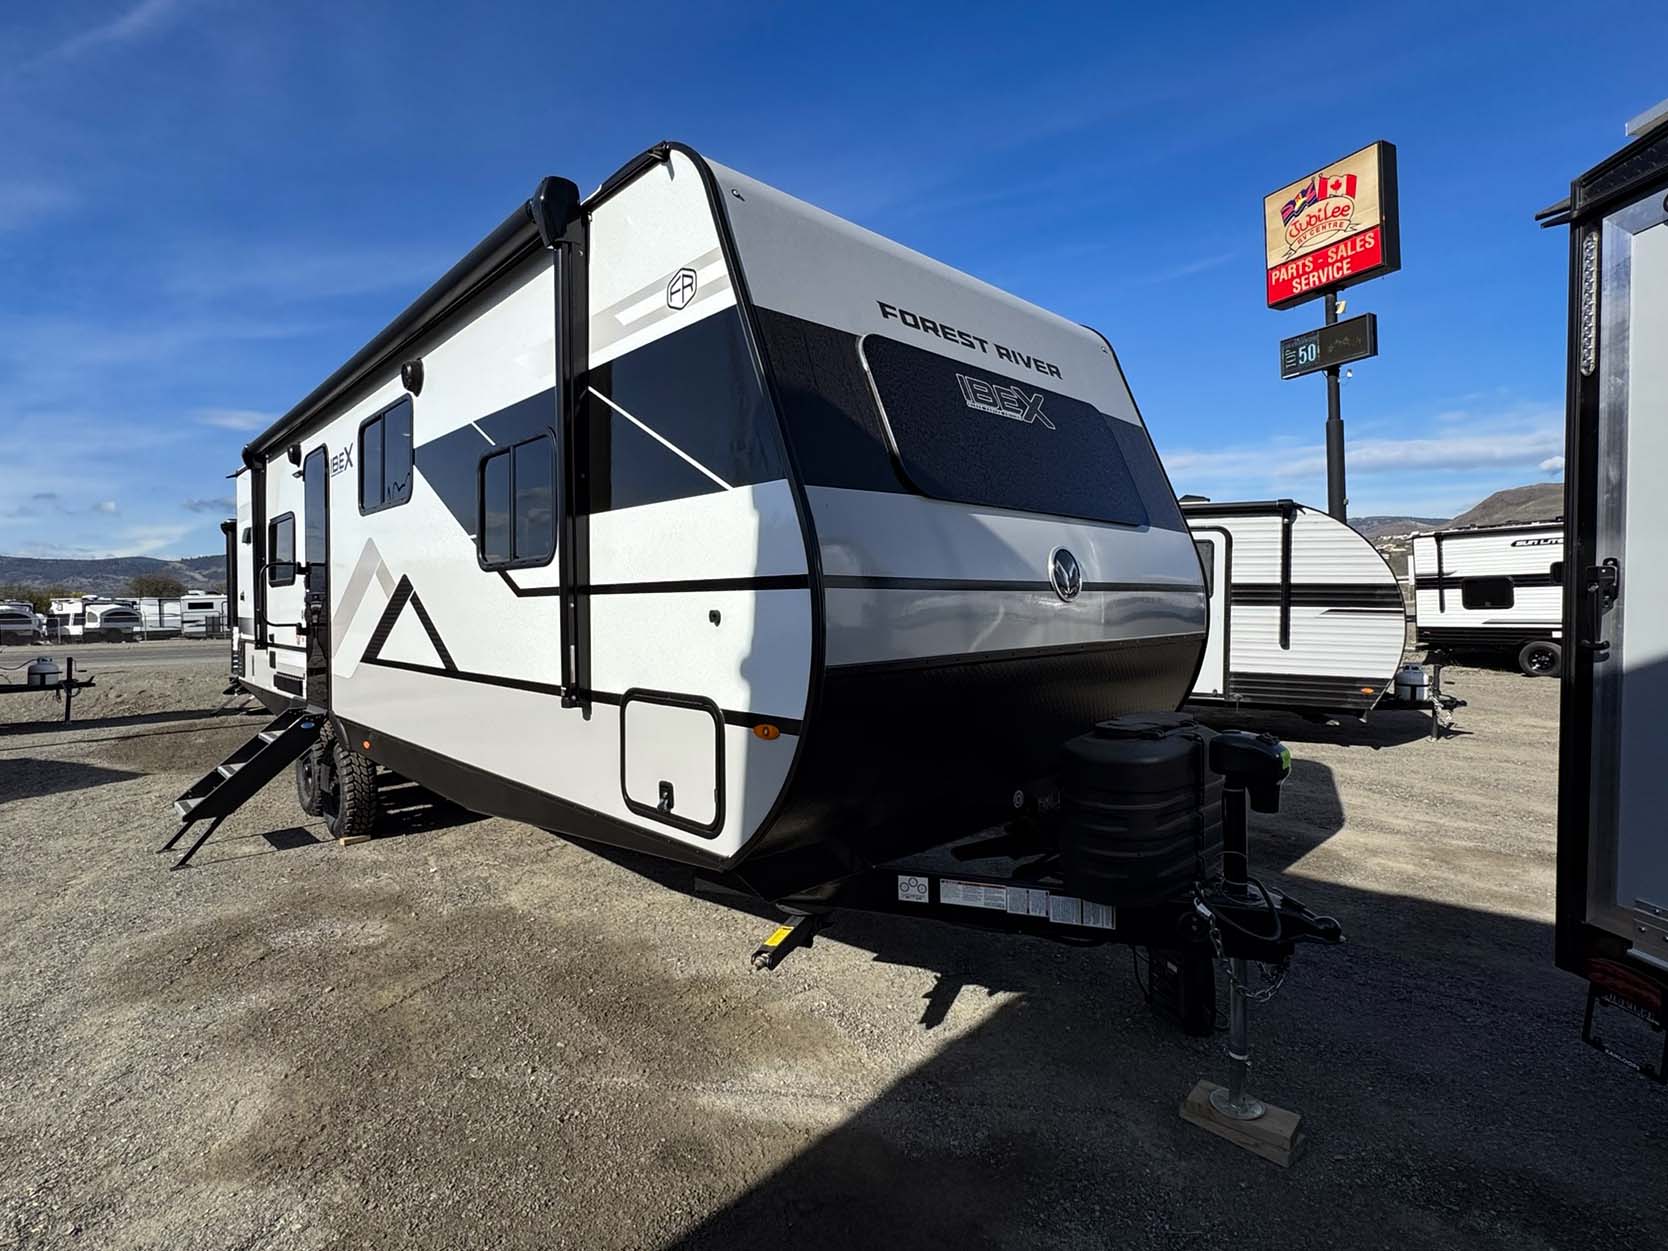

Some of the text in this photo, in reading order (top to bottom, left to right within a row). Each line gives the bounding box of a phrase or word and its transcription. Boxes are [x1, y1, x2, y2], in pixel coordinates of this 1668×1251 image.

[1297, 221, 1345, 245] RV CENTRE
[1271, 256, 1314, 285] PARTS
[1328, 233, 1376, 264] SALES
[1292, 258, 1352, 294] SERVICE
[876, 300, 1064, 380] FOREST RIVER
[1299, 343, 1316, 364] 50
[955, 373, 1056, 430] IBEX
[331, 442, 354, 473] IBEX
